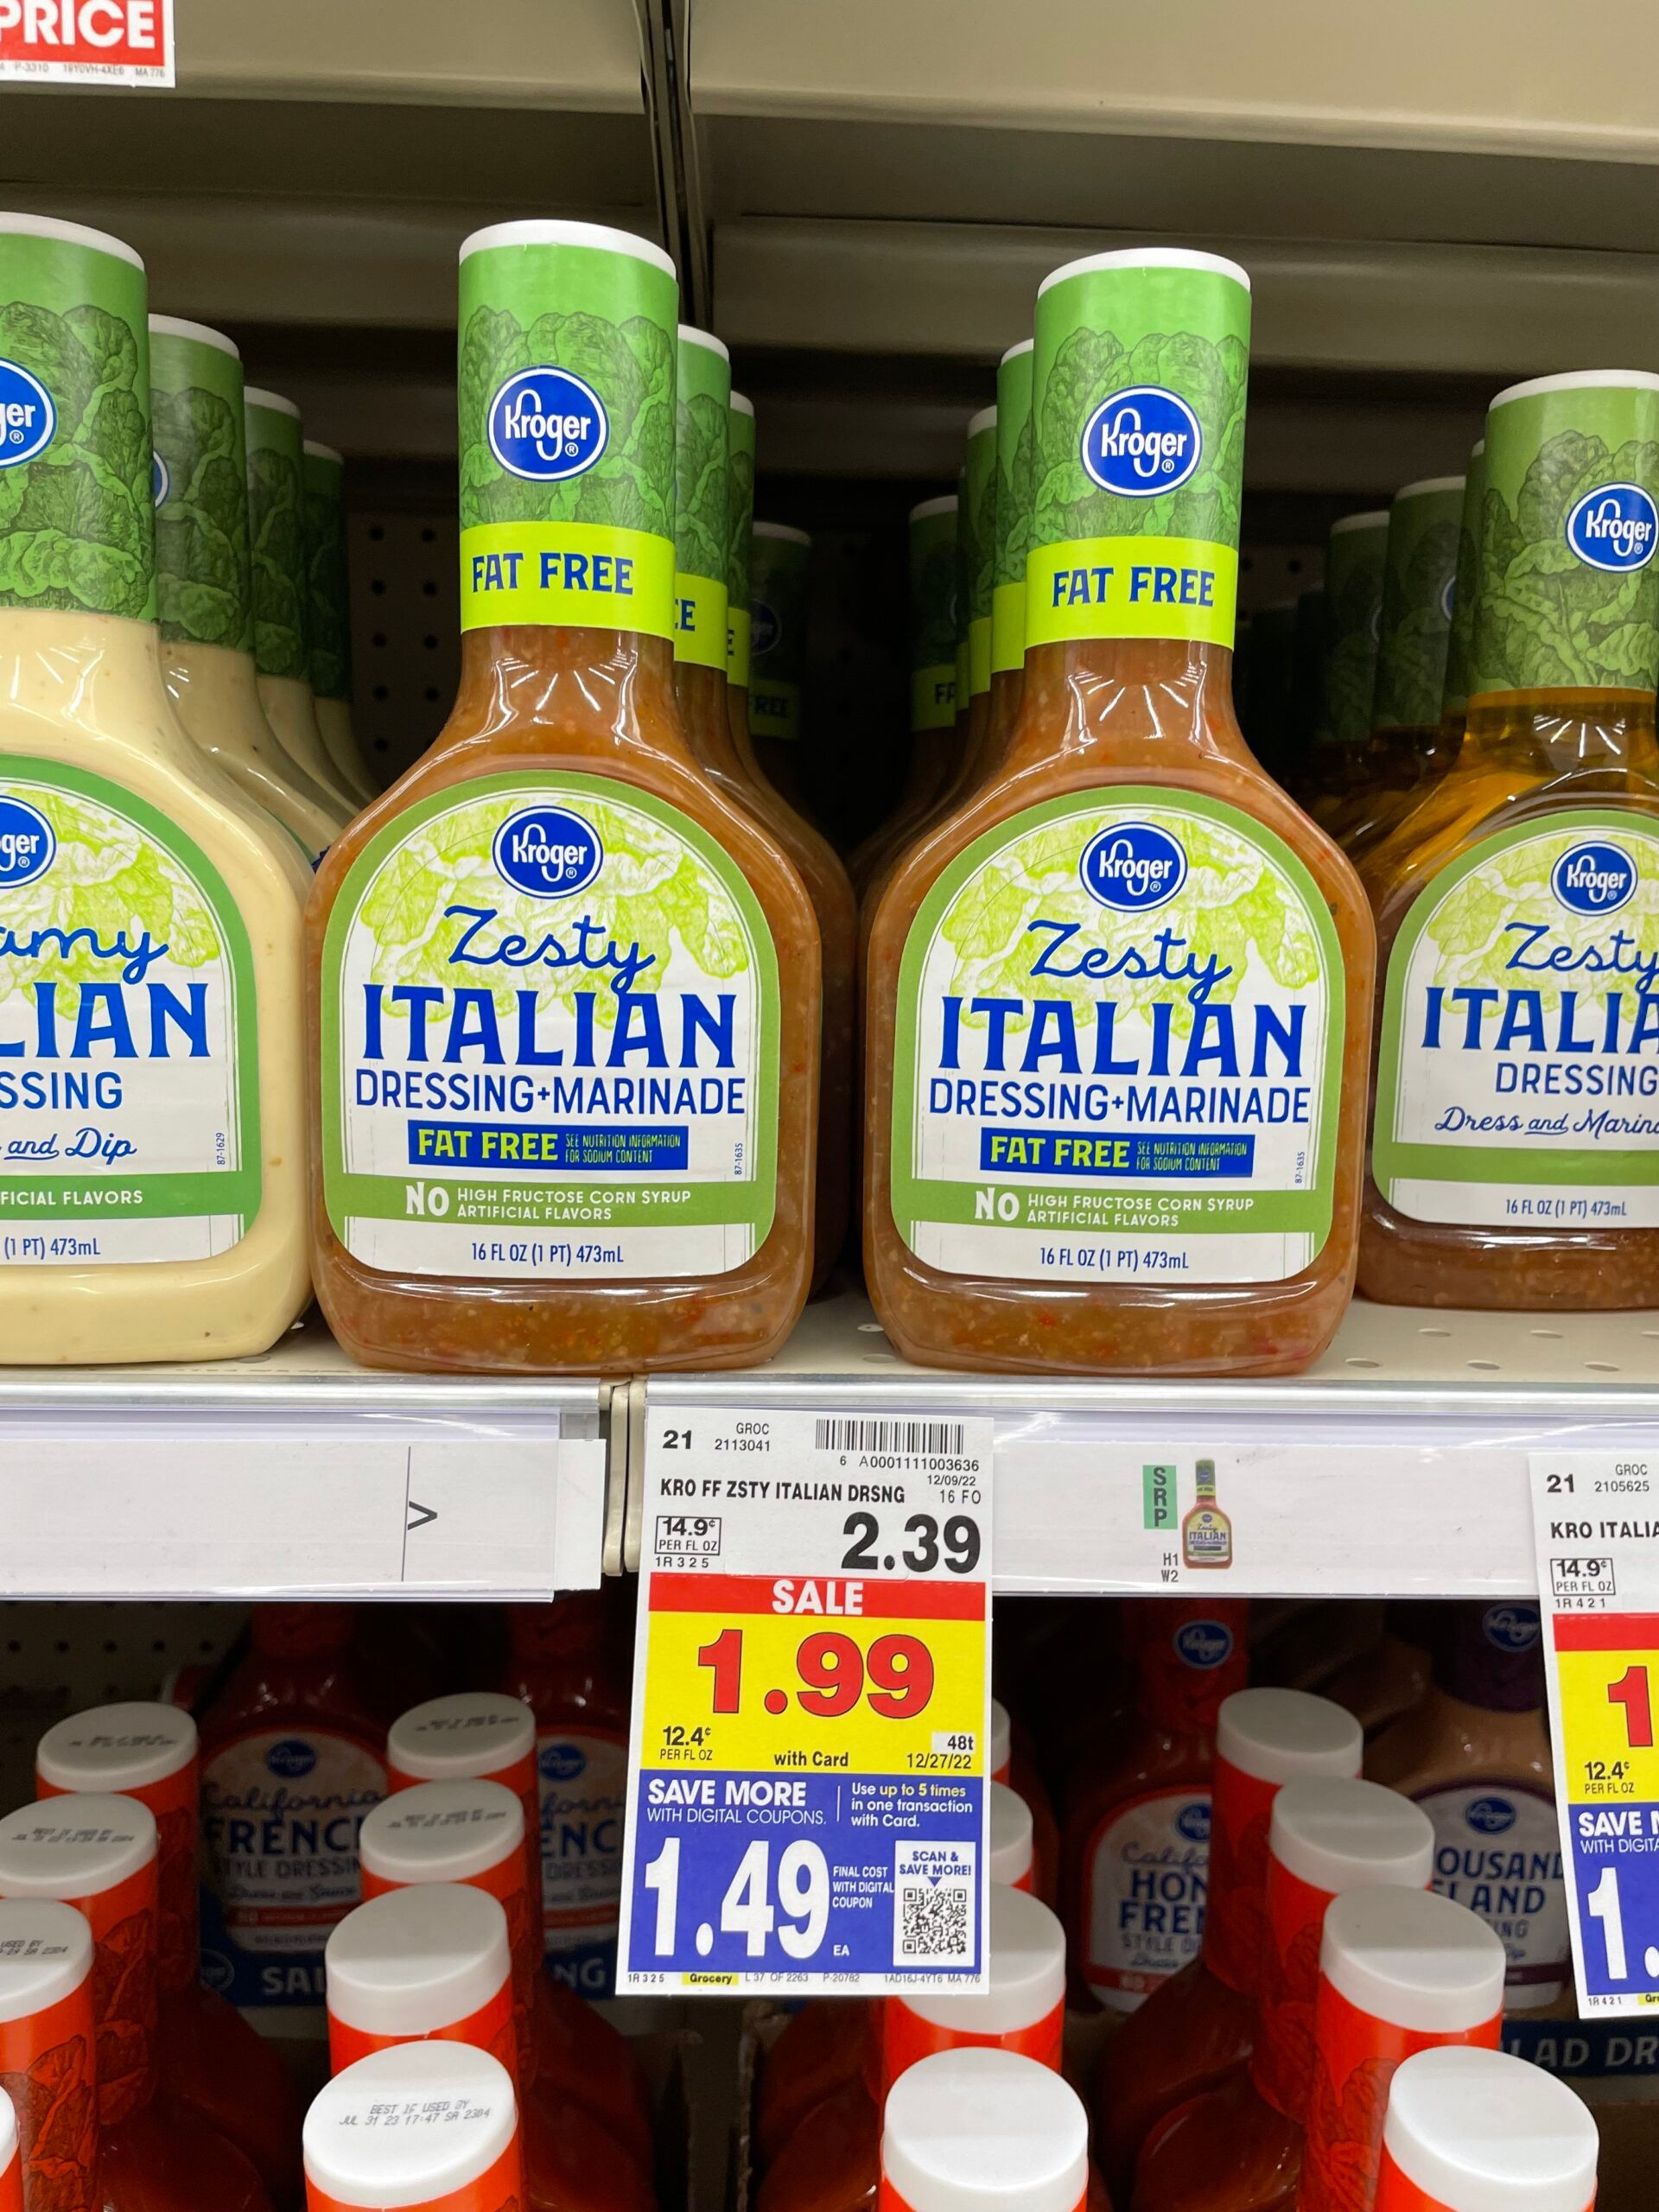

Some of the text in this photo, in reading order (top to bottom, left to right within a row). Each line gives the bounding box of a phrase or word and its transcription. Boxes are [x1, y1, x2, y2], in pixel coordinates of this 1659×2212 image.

[0, 0, 155, 48] PRICE
[505, 389, 591, 461] Kroger
[1101, 408, 1186, 477] Kroger
[1586, 498, 1651, 556] Kroger
[473, 553, 633, 595] FAT FREE
[1052, 566, 1215, 607] FAT FREE
[512, 823, 588, 882] Kroger
[1099, 839, 1173, 897] Kroger
[1567, 855, 1627, 903] Kroger
[443, 905, 656, 994] Zesty
[1504, 922, 1659, 994] Zesty
[1027, 919, 1232, 1006] Zesty
[363, 983, 736, 1068] ITALIAN
[938, 996, 1306, 1077] ITALIAN
[1496, 1063, 1658, 1096] DRESSING
[356, 1069, 746, 1116] DRESSING+MARINADE
[930, 1077, 1311, 1123] DRESSING+MARINADE
[1434, 1106, 1523, 1132] Dress
[1524, 1113, 1569, 1135] and
[3, 1128, 137, 1165] and Dip
[216, 1132, 225, 1166] 87-1629
[418, 1129, 558, 1160] FAT FREE
[566, 1135, 680, 1147] SEE NUTRITION INFORMATION
[565, 1150, 652, 1163] FOR SODIUM CONTENT
[734, 1142, 743, 1175] 87-1635
[990, 1135, 1130, 1168] FAT FREE
[1295, 1151, 1305, 1183] 87-1635
[63, 1190, 143, 1205] FLAVORS
[405, 1181, 449, 1217] NO
[457, 1187, 691, 1205] HIGH FRUCTOSE CORN SYRUP
[976, 1187, 1019, 1221] NO
[1027, 1193, 1201, 1211] HIGH FRUCTOSE CORN
[457, 1205, 612, 1221] ARTIFICIAL FLAVORS
[1590, 1201, 1627, 1216] 473mL
[23, 1236, 100, 1260] PT) 473mL
[472, 1243, 623, 1266] 16 FL OZ PT) 473mL
[736, 1422, 770, 1435] GROC
[662, 1429, 692, 1450] 21
[715, 1439, 770, 1452] 2113041
[840, 1455, 979, 1472] 6 A0001111003636
[1616, 1465, 1647, 1476] GROC
[927, 1475, 976, 1487] 12/09/22
[1547, 1474, 1574, 1493] 21
[1595, 1481, 1649, 1492] 2105625
[661, 1478, 905, 1503] KRO FF ZSTY ITALIAN DRSNG
[940, 1490, 981, 1504] 16 FO
[1551, 1522, 1592, 1538] KRO
[658, 1540, 717, 1551] PER FL OZ
[841, 1511, 981, 1573] 2.39
[1163, 1553, 1178, 1566] H1
[1161, 1570, 1179, 1582] W2
[1556, 1581, 1611, 1592] PER FL OZ
[772, 1580, 863, 1615] SALE
[698, 1629, 934, 1719] 1.99
[947, 1735, 974, 1751] 48t
[660, 1749, 712, 1761] PER FL OZ
[774, 1751, 849, 1768] with Card
[906, 1754, 971, 1770] 12/27/22
[648, 1779, 806, 1806] SAVE MORE
[852, 1783, 966, 1799] Use up to 5 times
[1585, 1783, 1635, 1794] PER FL OZ
[851, 1799, 972, 1813] in one transaction
[647, 1808, 826, 1825] WITH DIGITAL COUPONS.
[851, 1815, 919, 1827] with Card.
[1579, 1811, 1643, 1837] SAVE
[1580, 1840, 1614, 1853] WITH
[912, 1851, 946, 1862] SCAN
[833, 1866, 887, 1878] FINAL COST
[899, 1864, 971, 1876] SAVE MORE!
[833, 1882, 894, 1893] WITH DIGITAL
[645, 1837, 830, 1959] 1.49
[832, 1897, 873, 1909] COUPON
[833, 1945, 849, 1956] EA
[690, 1974, 732, 1985] Grocery
[370, 2104, 398, 2114] BEST
[423, 2101, 450, 2113] USED
[339, 2115, 399, 2125] JUL 23
